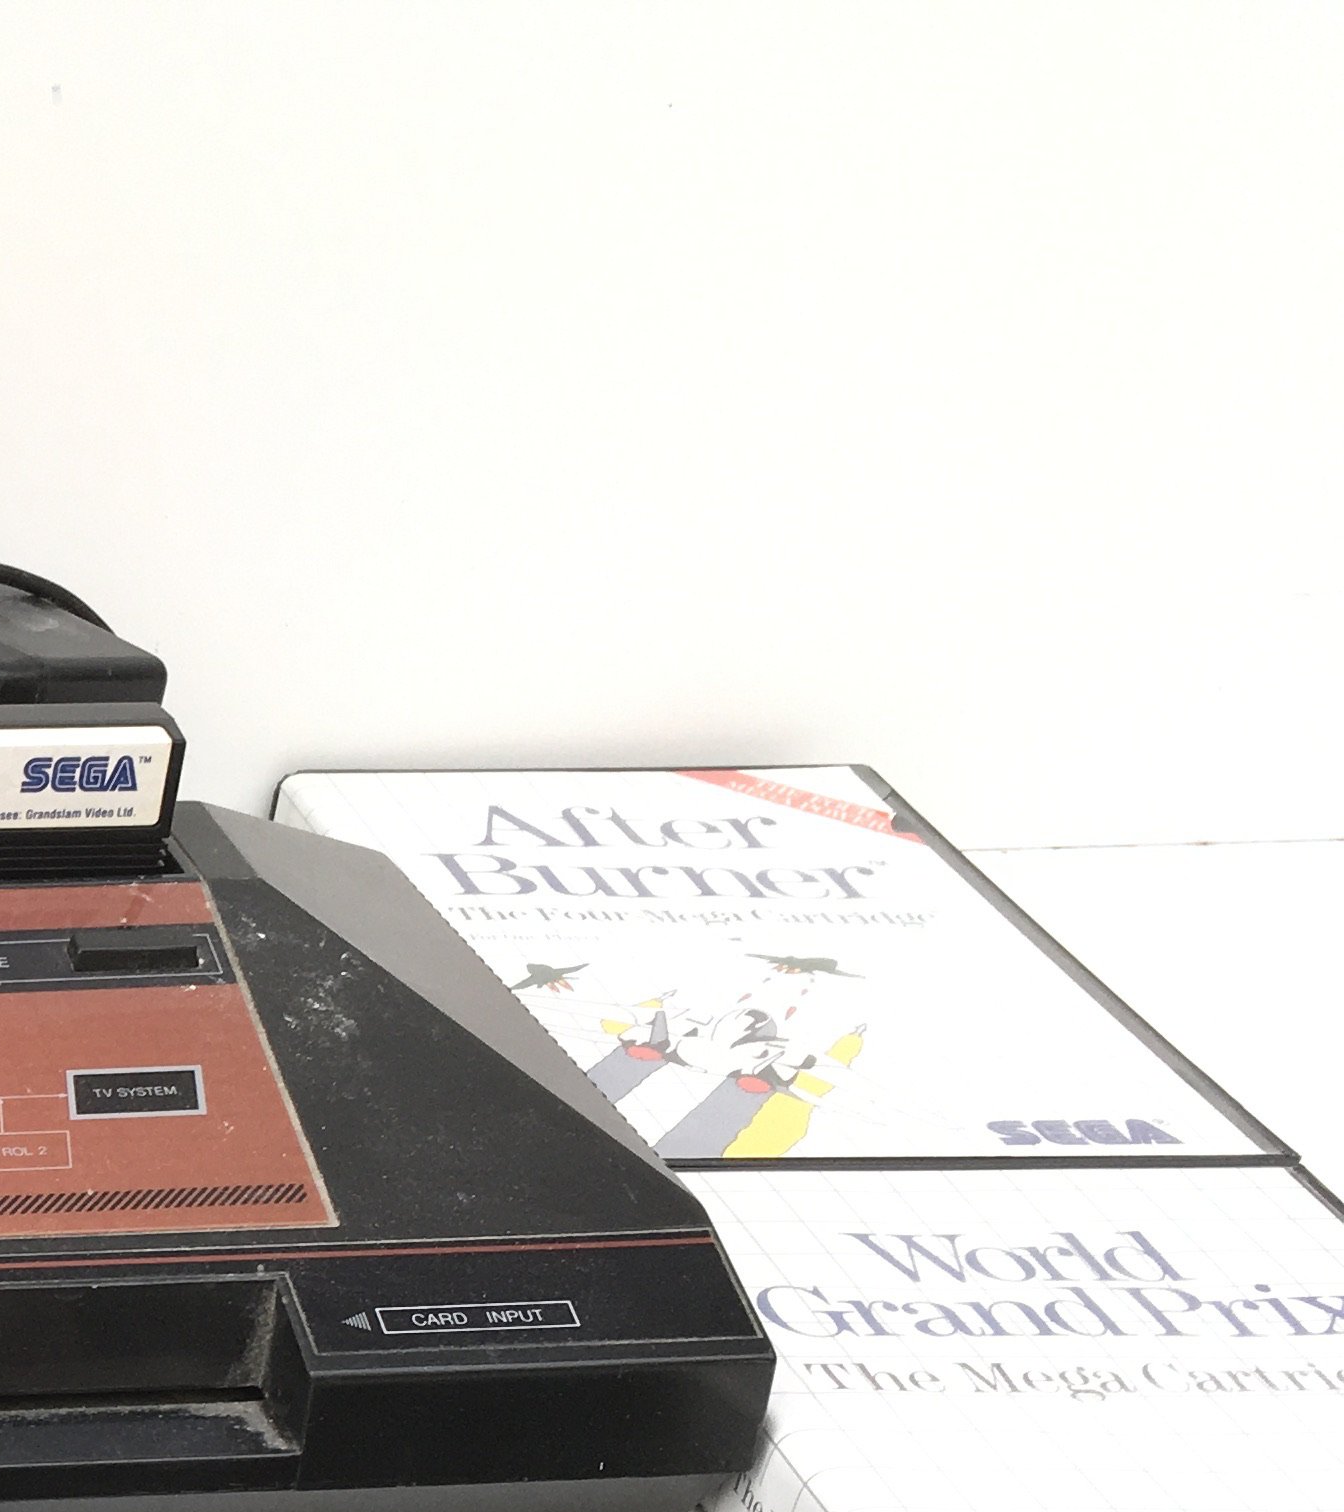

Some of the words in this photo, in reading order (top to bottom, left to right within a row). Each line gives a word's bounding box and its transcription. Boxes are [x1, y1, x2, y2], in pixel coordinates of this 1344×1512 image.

[20, 755, 137, 792] SEGA
[25, 809, 81, 820] Grandslam
[84, 808, 113, 818] Video
[116, 807, 136, 818] Ltd.
[473, 804, 778, 850] After
[422, 852, 876, 900] Burner
[449, 905, 527, 923] The
[538, 905, 632, 923] Four
[641, 906, 743, 927] Mega
[752, 906, 937, 928] Cartridge
[93, 1087, 111, 1099] TV
[114, 1085, 178, 1098] SYSTEM
[987, 1119, 1183, 1145] SEGA
[37, 1144, 47, 1156] 2
[839, 1230, 1198, 1283] World
[411, 1311, 468, 1327] CARD
[486, 1308, 544, 1324] INPUT
[756, 1285, 1141, 1338] Grand
[805, 1362, 945, 1392] The
[956, 1362, 1137, 1402] Mega
